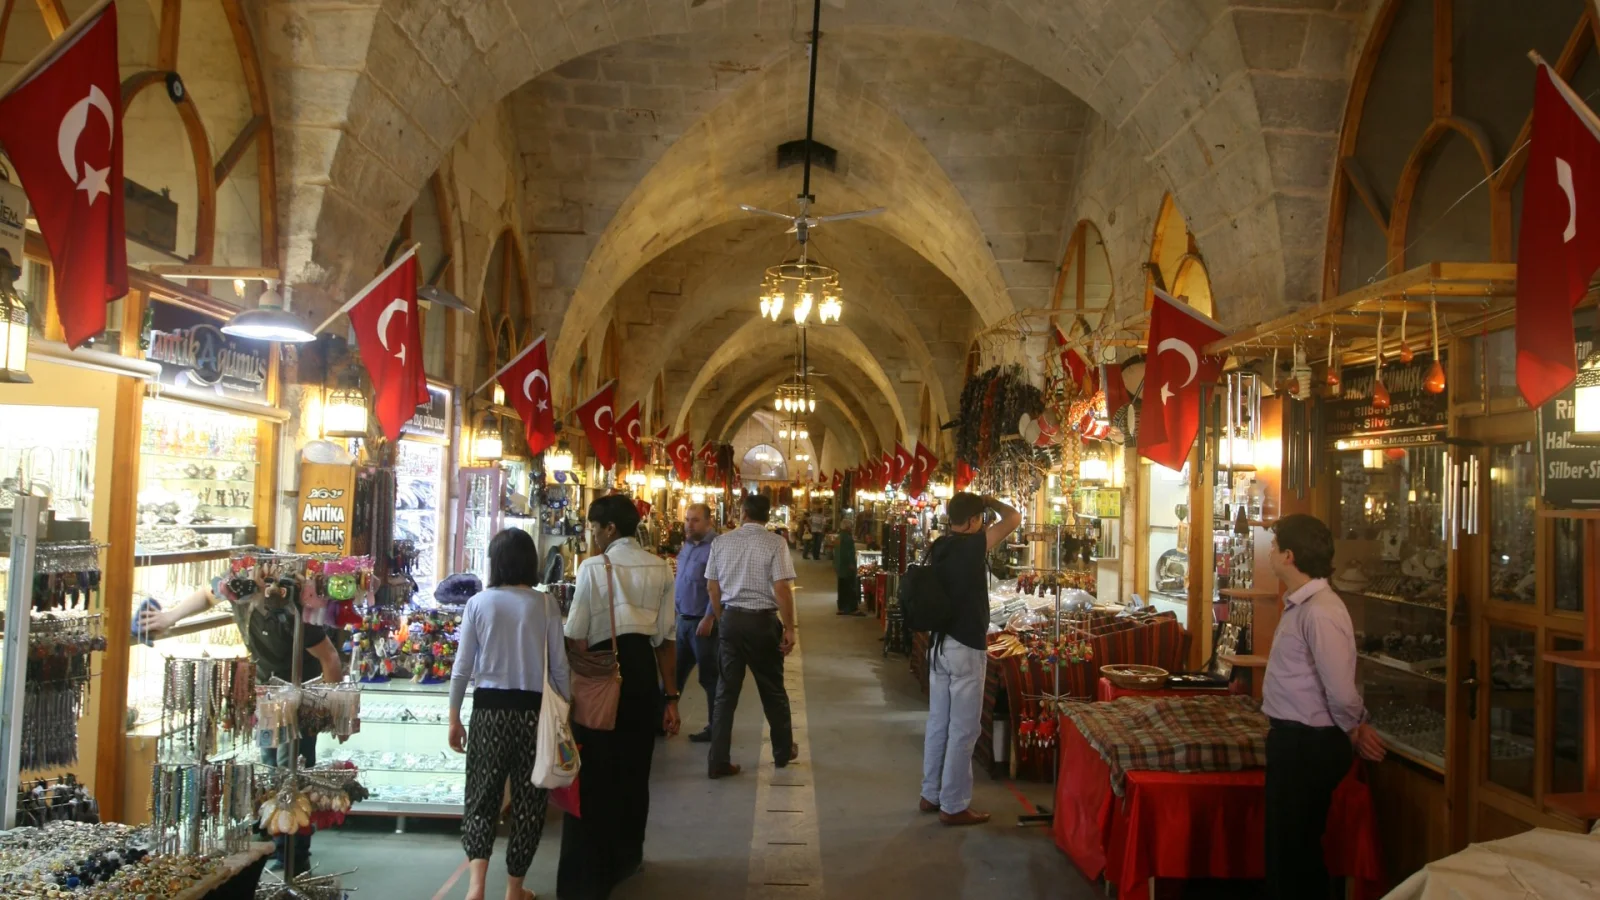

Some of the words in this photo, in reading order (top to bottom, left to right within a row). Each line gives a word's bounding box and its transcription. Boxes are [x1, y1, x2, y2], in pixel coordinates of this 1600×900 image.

[1363, 417, 1395, 429] Silver
[302, 503, 345, 522] ANTİKA
[301, 525, 345, 549] GÜMÜŞ
